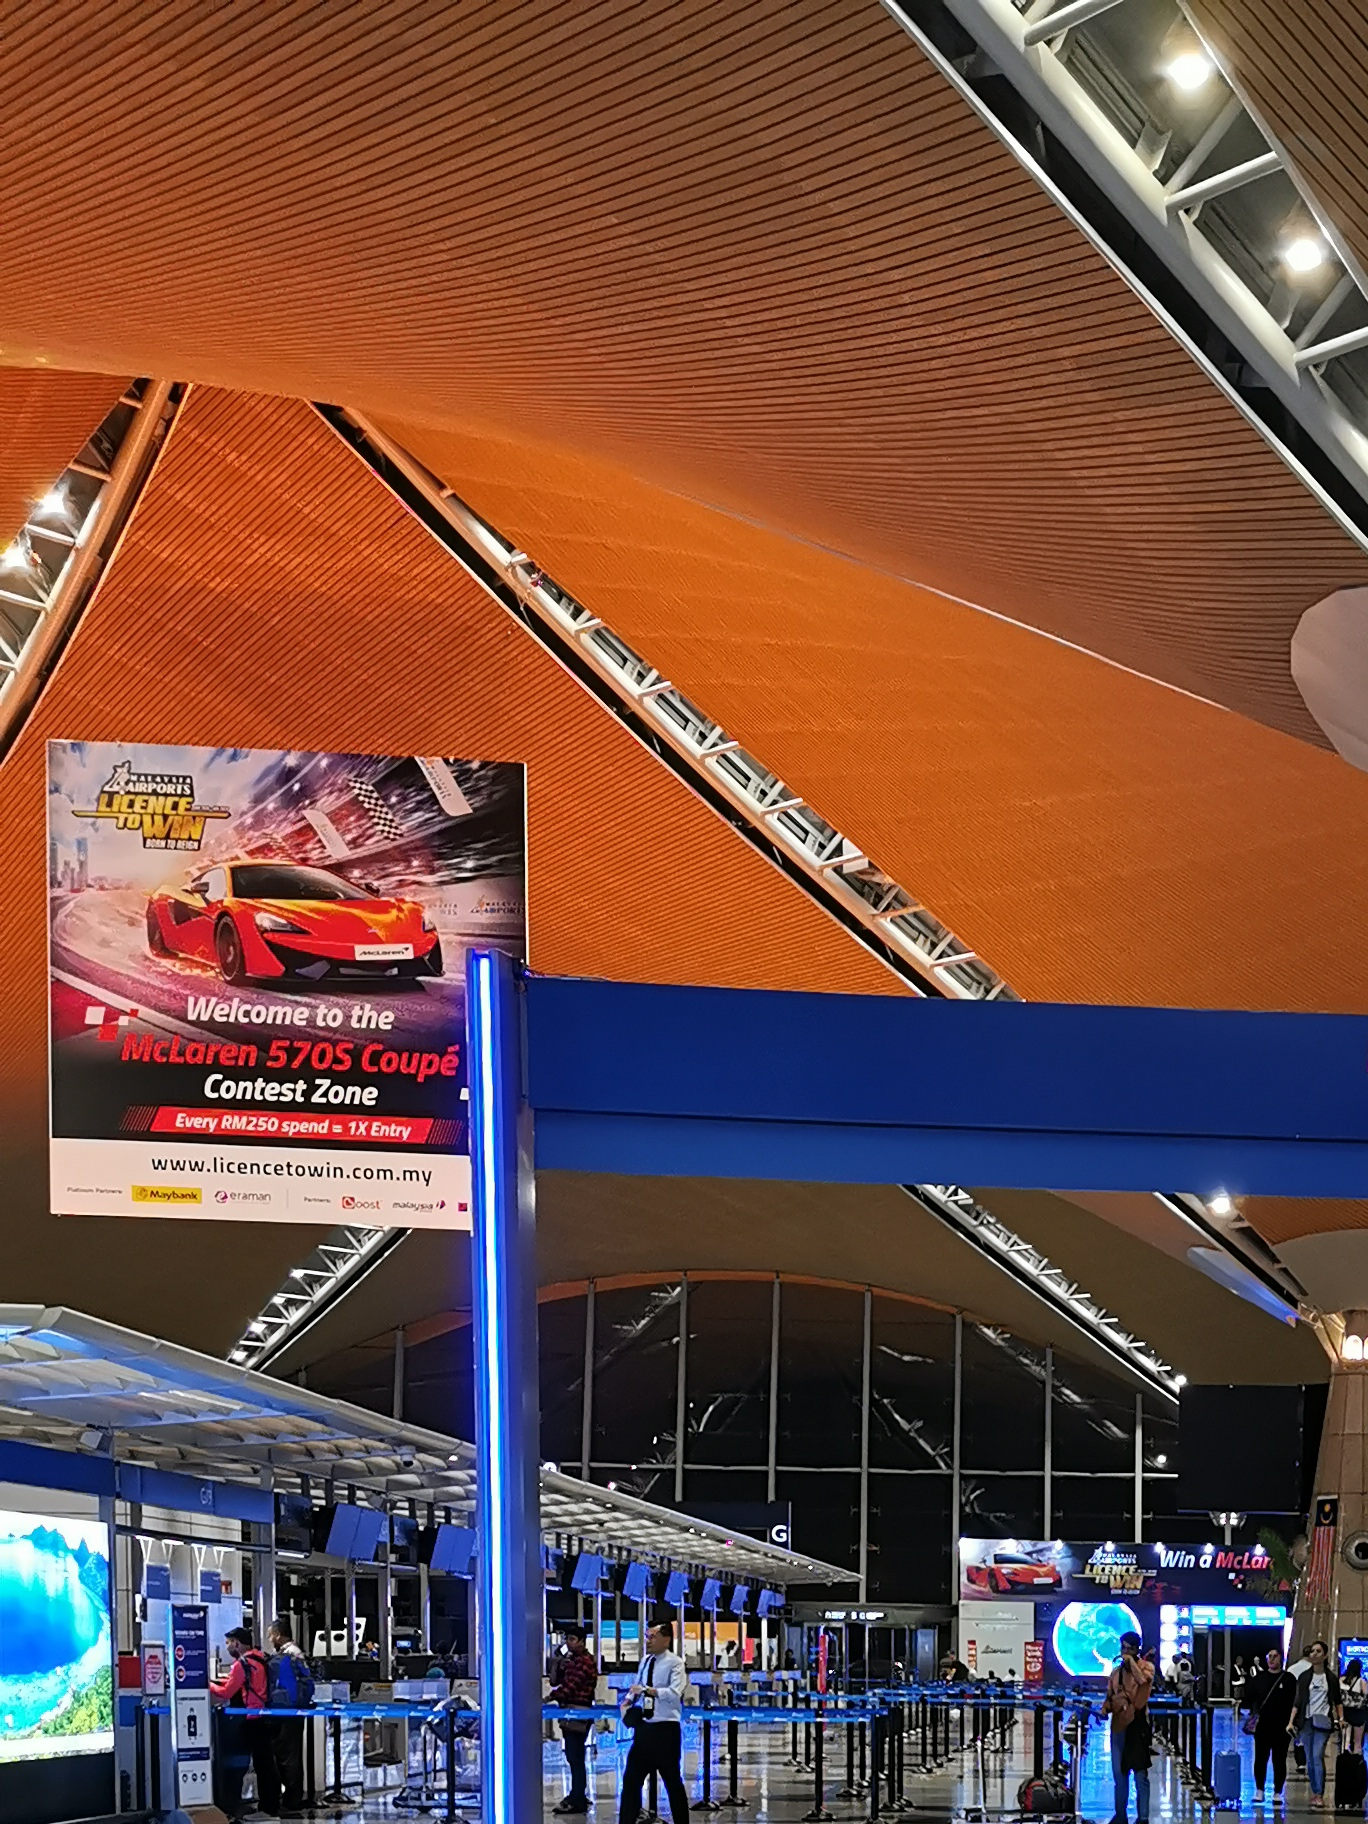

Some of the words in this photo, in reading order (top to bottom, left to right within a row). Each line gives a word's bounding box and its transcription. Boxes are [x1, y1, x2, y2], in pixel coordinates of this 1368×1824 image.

[125, 782, 191, 795] AIRPORTS
[130, 774, 191, 784] MALAYSIA
[98, 794, 193, 815] LICENCE
[116, 814, 141, 829] TO
[142, 814, 205, 840] WIN
[186, 996, 308, 1026] Welcome
[315, 1004, 343, 1028] to
[350, 1003, 395, 1030] the
[121, 1032, 258, 1067] McLaren
[266, 1039, 355, 1073] 570S
[361, 1044, 460, 1082] Coupé
[203, 1073, 307, 1102] Contest
[311, 1079, 379, 1106] Zone
[175, 1113, 218, 1133] Every
[221, 1115, 278, 1132] RM250
[281, 1117, 328, 1136] spend
[347, 1120, 367, 1136] 1X
[370, 1122, 411, 1141] Entry
[151, 1157, 432, 1186] www.licencetowin.com.my
[149, 1190, 198, 1202] Maybank
[229, 1192, 272, 1202] eraman
[392, 1200, 433, 1211] malaysia
[771, 1524, 788, 1543] G
[1084, 1564, 1138, 1575] LICENCE
[1159, 1549, 1195, 1569] Win
[1199, 1554, 1213, 1569] a
[1215, 1551, 1273, 1570] McLar
